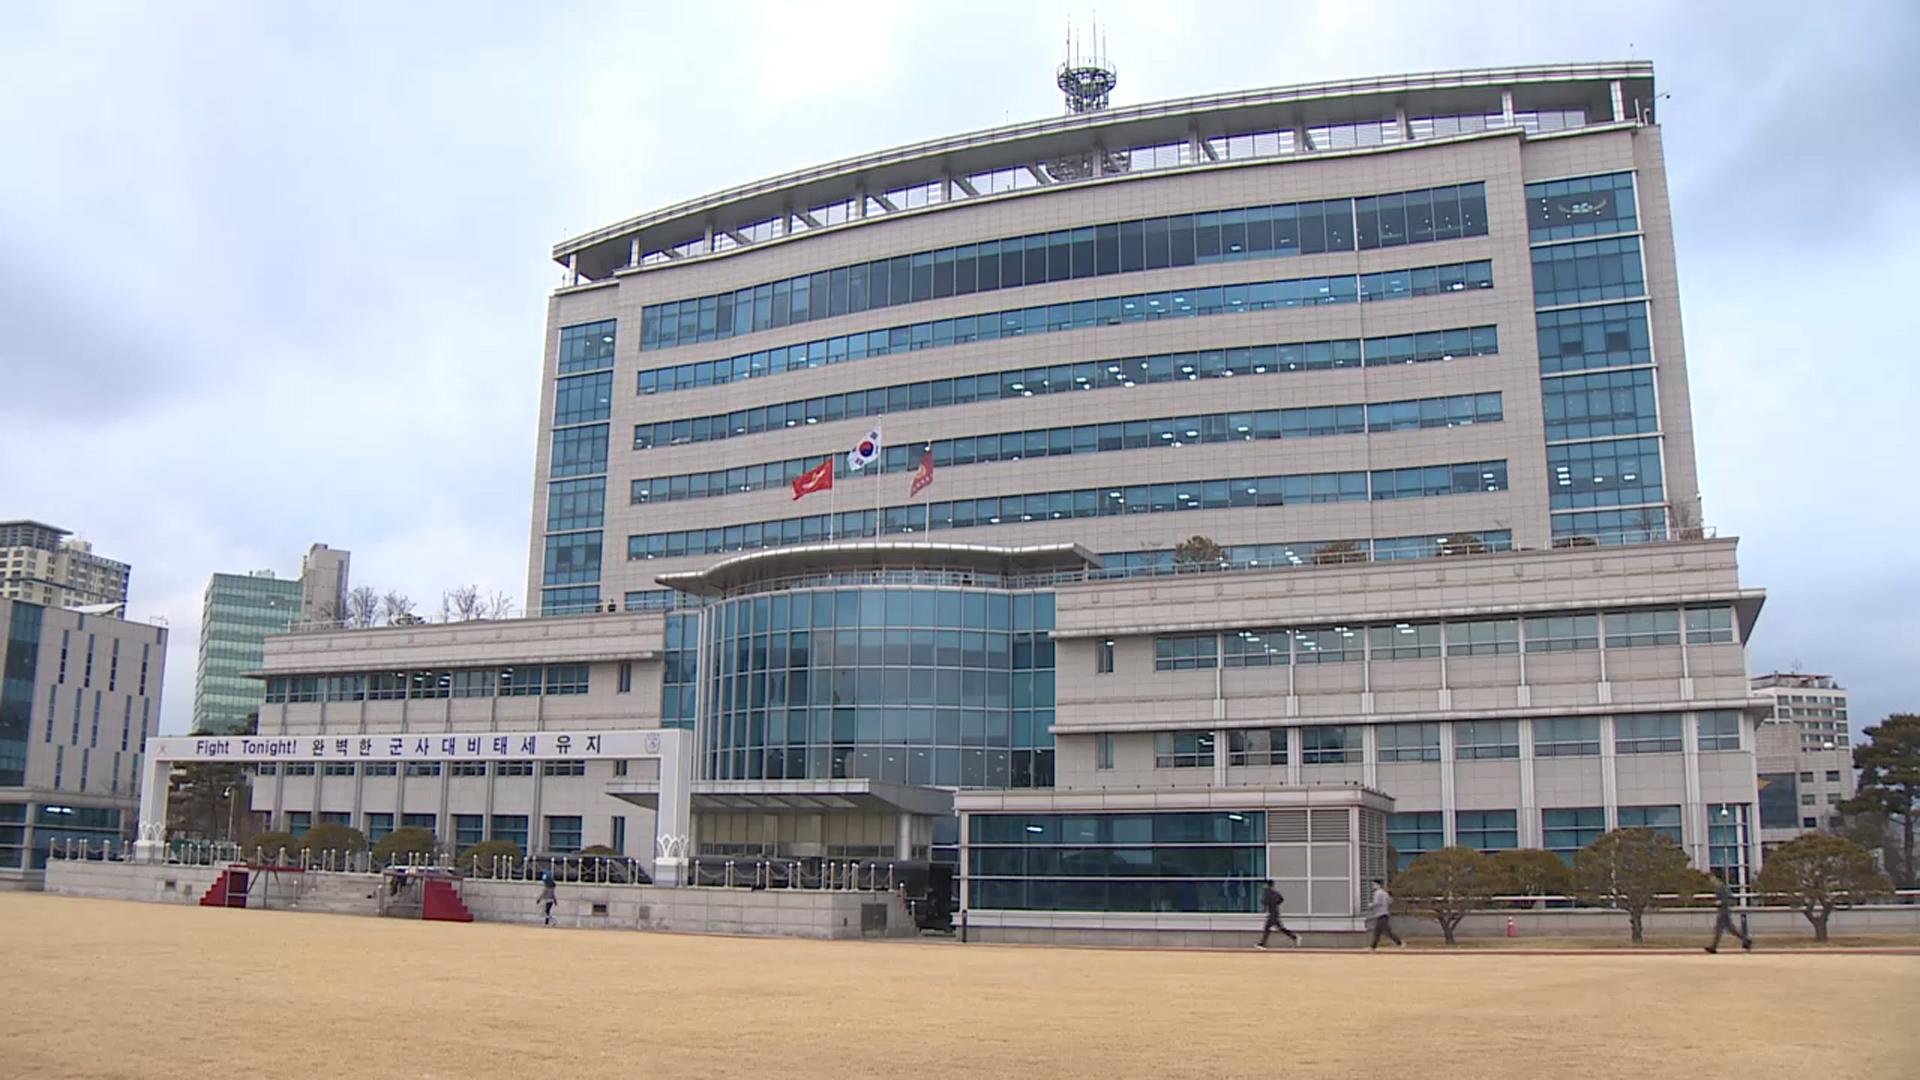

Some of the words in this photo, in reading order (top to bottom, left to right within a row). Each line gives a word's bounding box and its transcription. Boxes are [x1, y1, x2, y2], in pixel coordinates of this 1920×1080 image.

[196, 740, 229, 756] Fight
[242, 739, 297, 757] Tonight!
[312, 738, 372, 757] 완벽한
[389, 736, 536, 756] 군사대비태세
[555, 734, 601, 755] 유지
